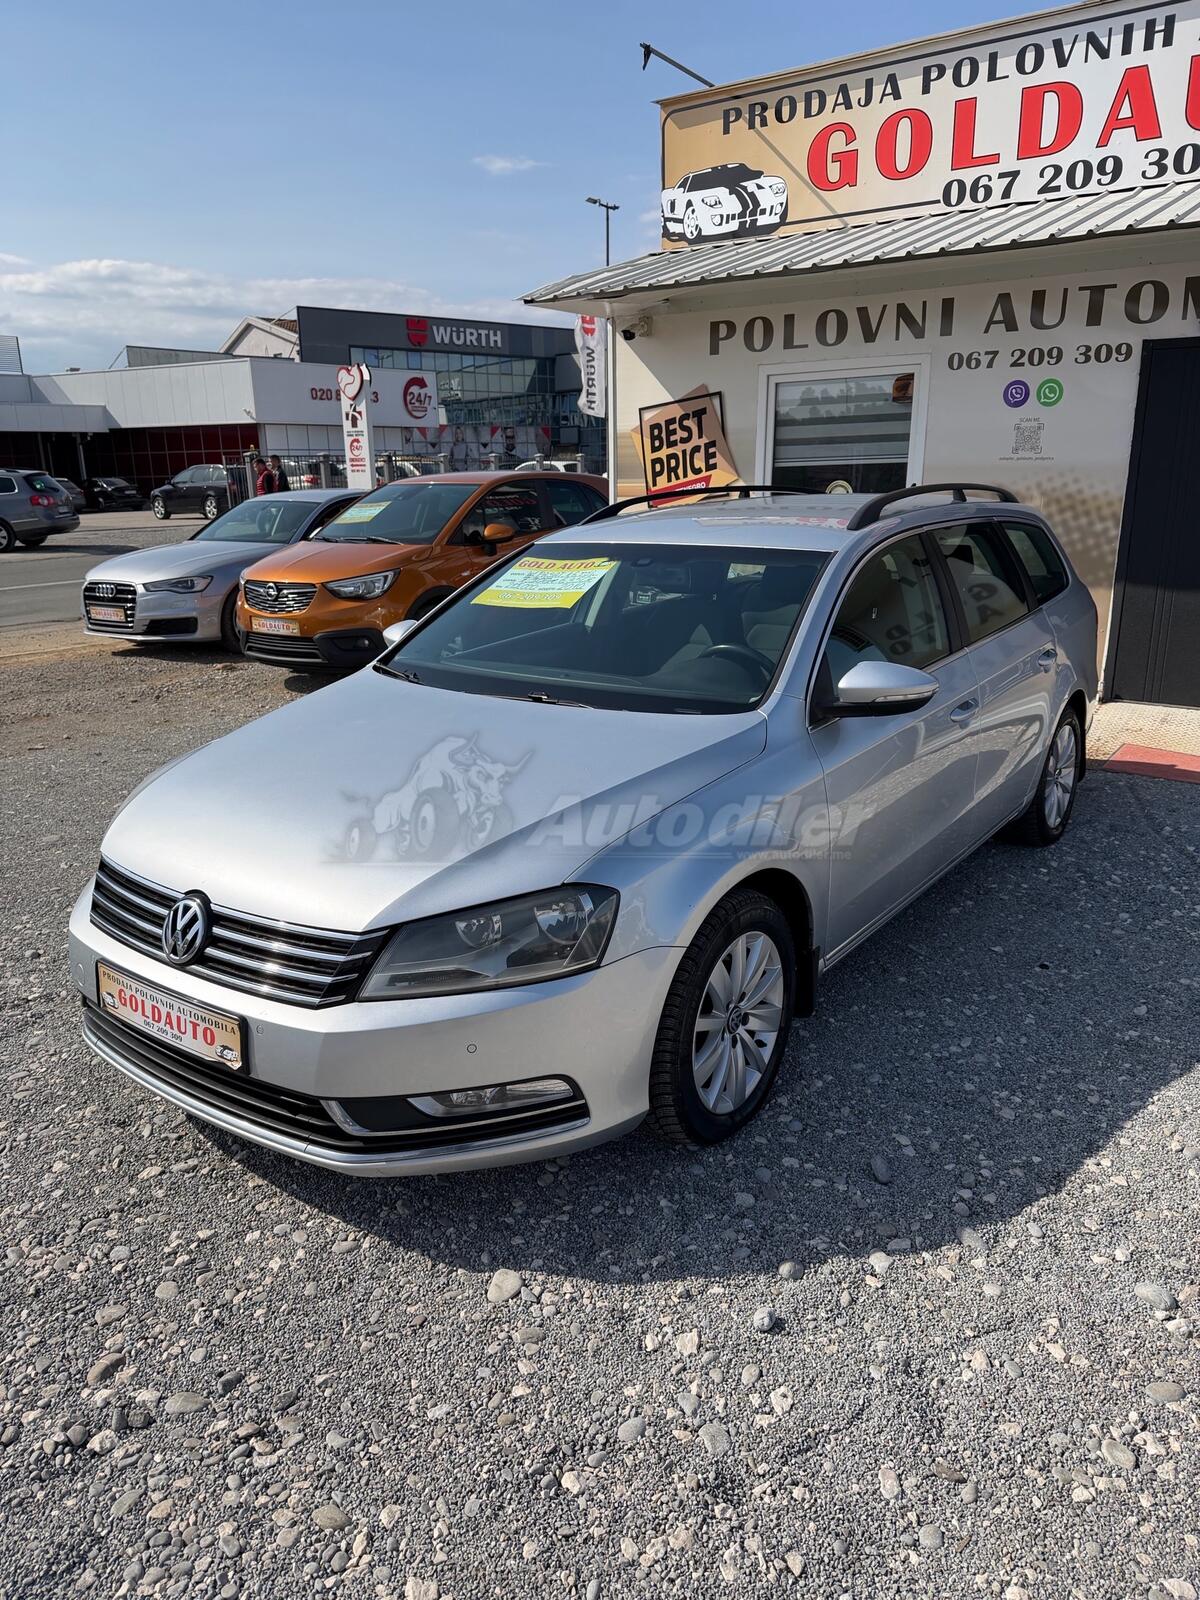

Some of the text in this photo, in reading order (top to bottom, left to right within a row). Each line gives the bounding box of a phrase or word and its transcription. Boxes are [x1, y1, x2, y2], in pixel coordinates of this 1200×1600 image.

[722, 14, 1176, 135] PRODAJA POLOVNIH
[806, 55, 1200, 192] GOLDA
[941, 169, 1021, 207] 067
[1037, 154, 1123, 196] 209
[431, 325, 501, 347] WÜRTH
[709, 296, 956, 355] POLOVNI
[947, 342, 1134, 370] 067 209 309
[311, 388, 332, 400] 020
[408, 392, 432, 406] 24/7
[649, 407, 707, 453] BEST
[651, 440, 717, 487] PRICE
[518, 560, 595, 569] GOLD AUTO
[258, 621, 291, 631] GOLDAUTO
[102, 970, 236, 1036] PRODAJA POLOVNIH AUTOMOBILA
[118, 987, 216, 1047] GOLDAUTO
